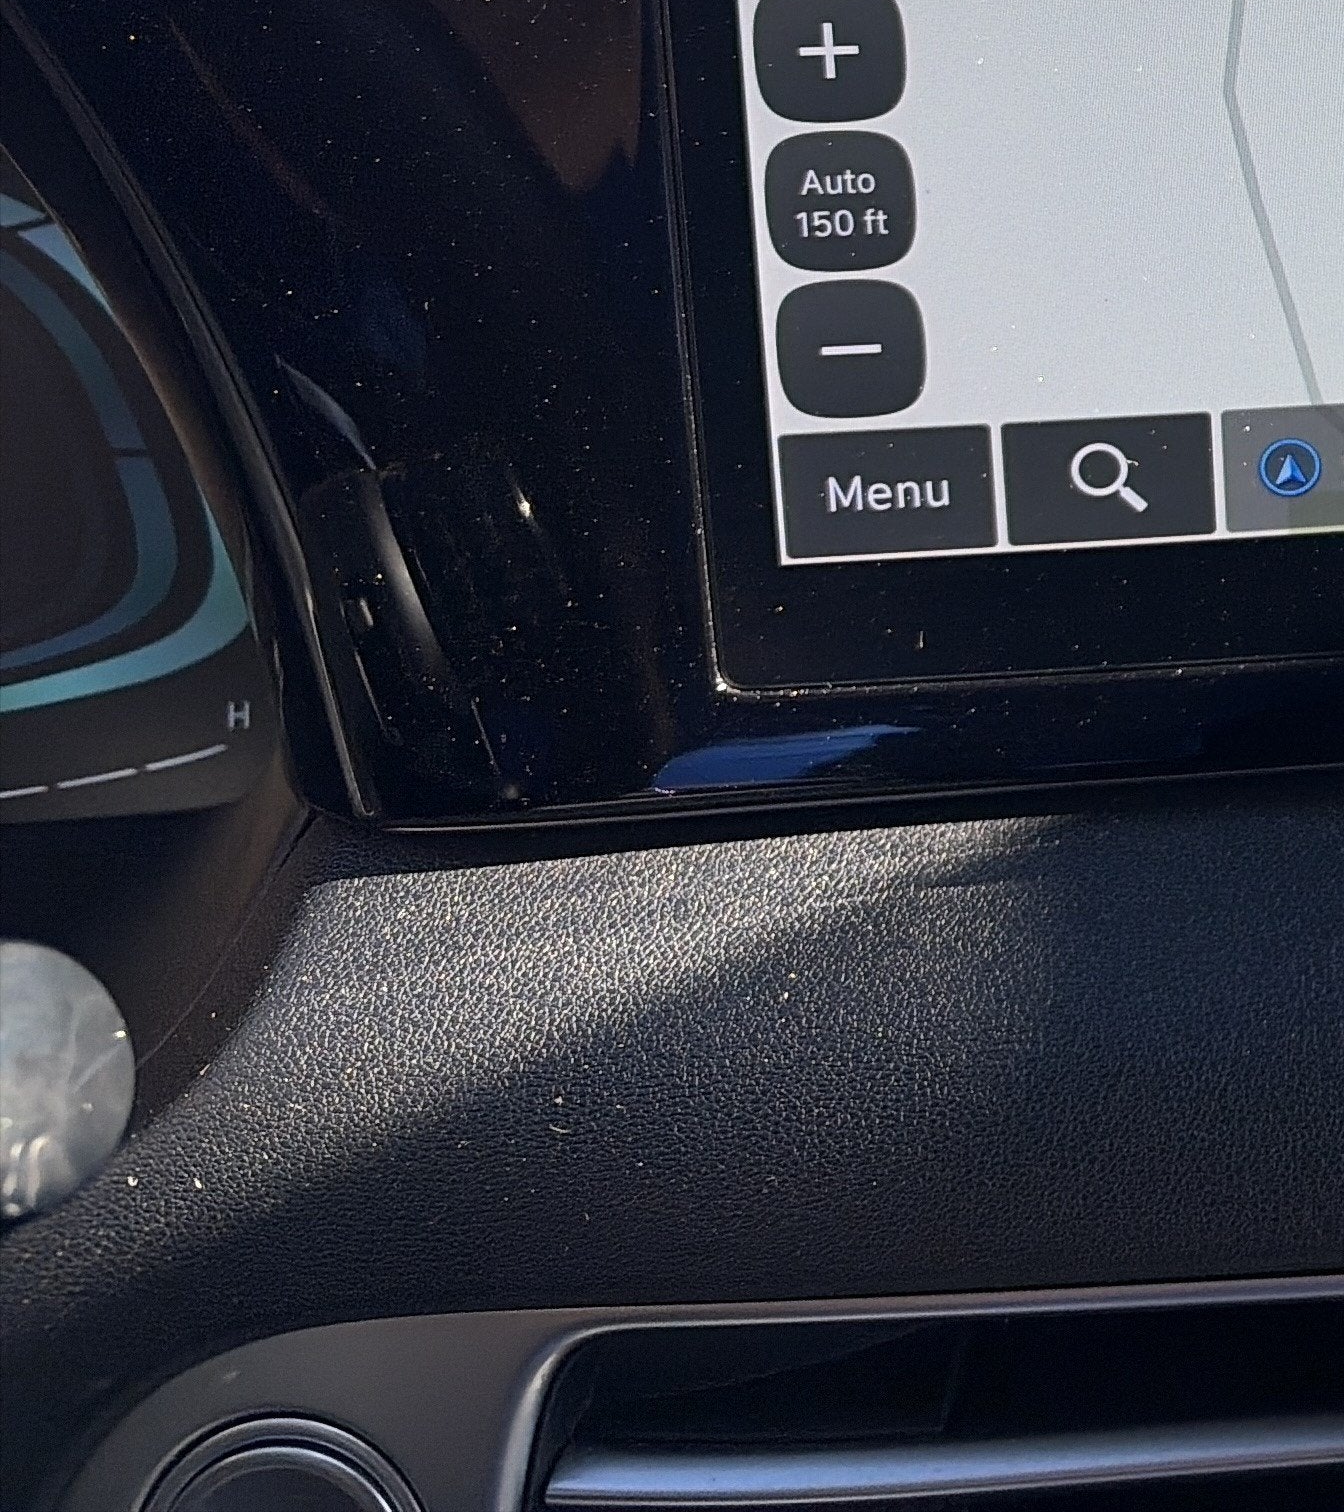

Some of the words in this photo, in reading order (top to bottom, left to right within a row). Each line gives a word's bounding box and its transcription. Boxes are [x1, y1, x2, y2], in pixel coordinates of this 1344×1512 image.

[799, 168, 876, 197] Auto
[796, 209, 855, 238] 150
[863, 208, 889, 236] ft
[825, 472, 951, 514] Menu
[226, 699, 252, 730] H
